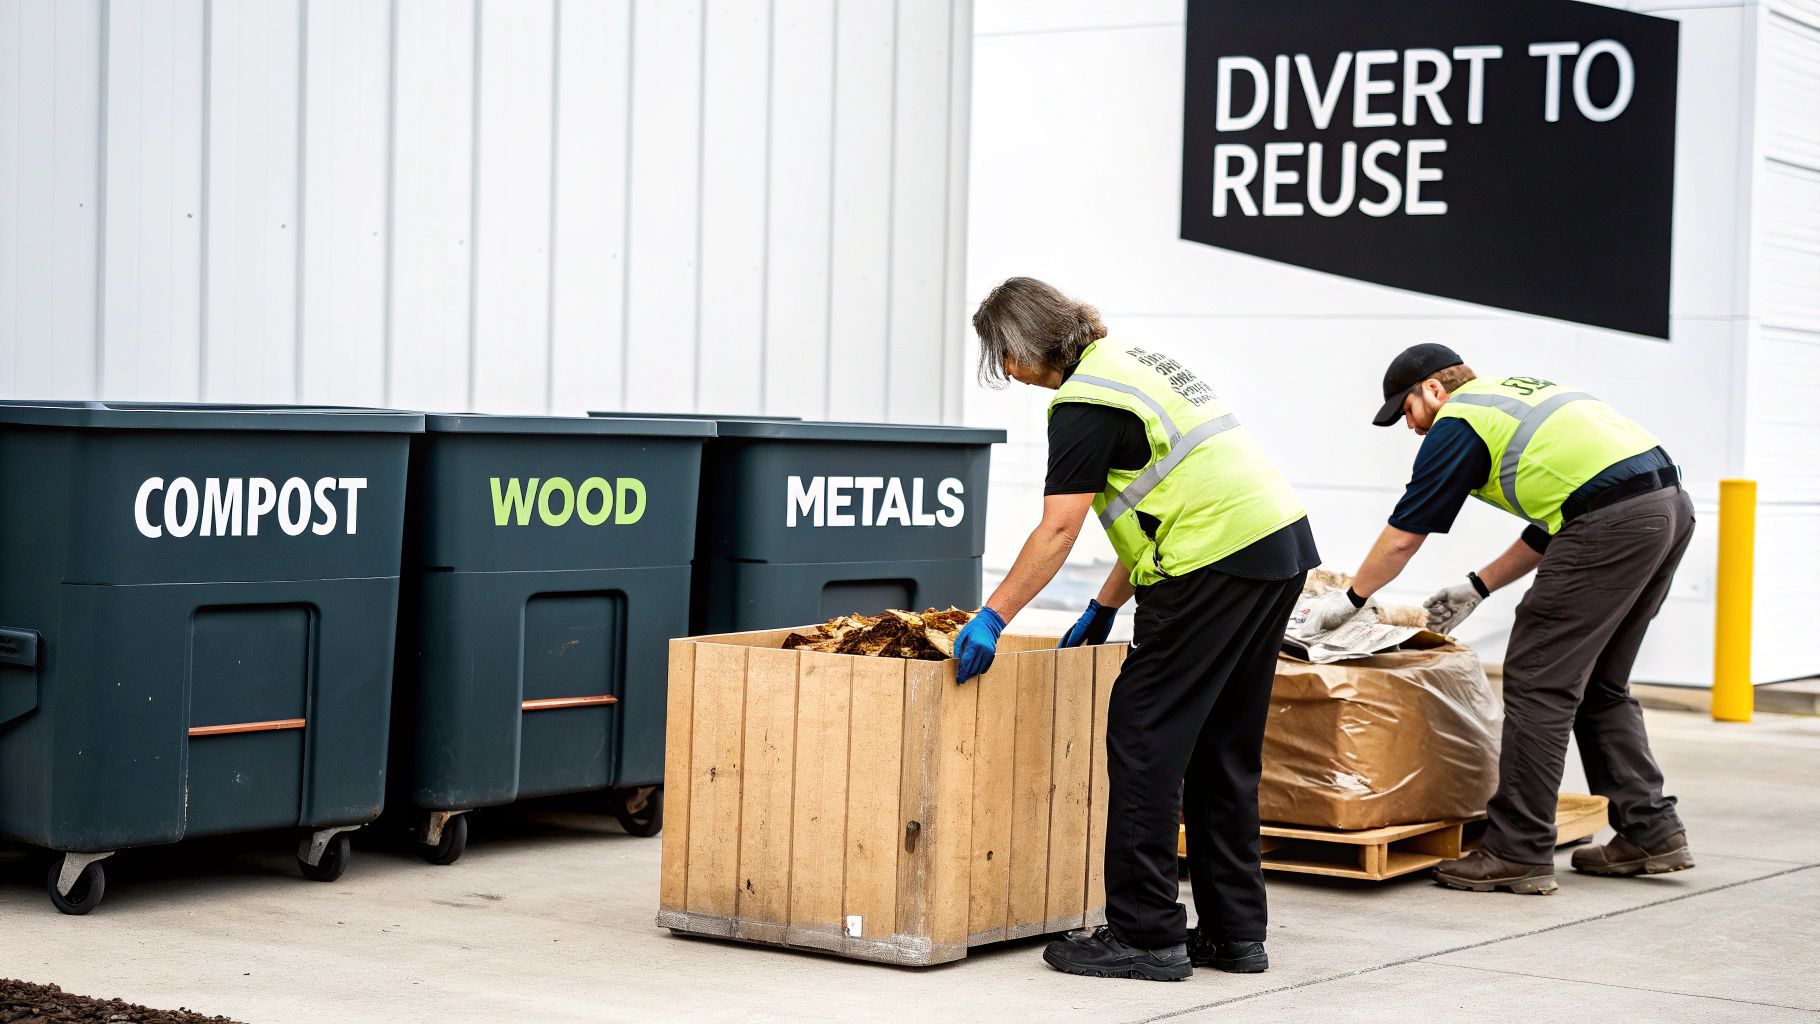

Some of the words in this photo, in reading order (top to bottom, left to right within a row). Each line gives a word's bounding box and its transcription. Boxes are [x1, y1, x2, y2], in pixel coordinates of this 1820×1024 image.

[1214, 44, 1503, 132] DIVERT
[1528, 39, 1635, 123] TO
[1211, 138, 1449, 219] REUSE
[134, 476, 368, 539] COMPOST
[489, 476, 647, 527] WOOD
[786, 475, 966, 528] METALS
